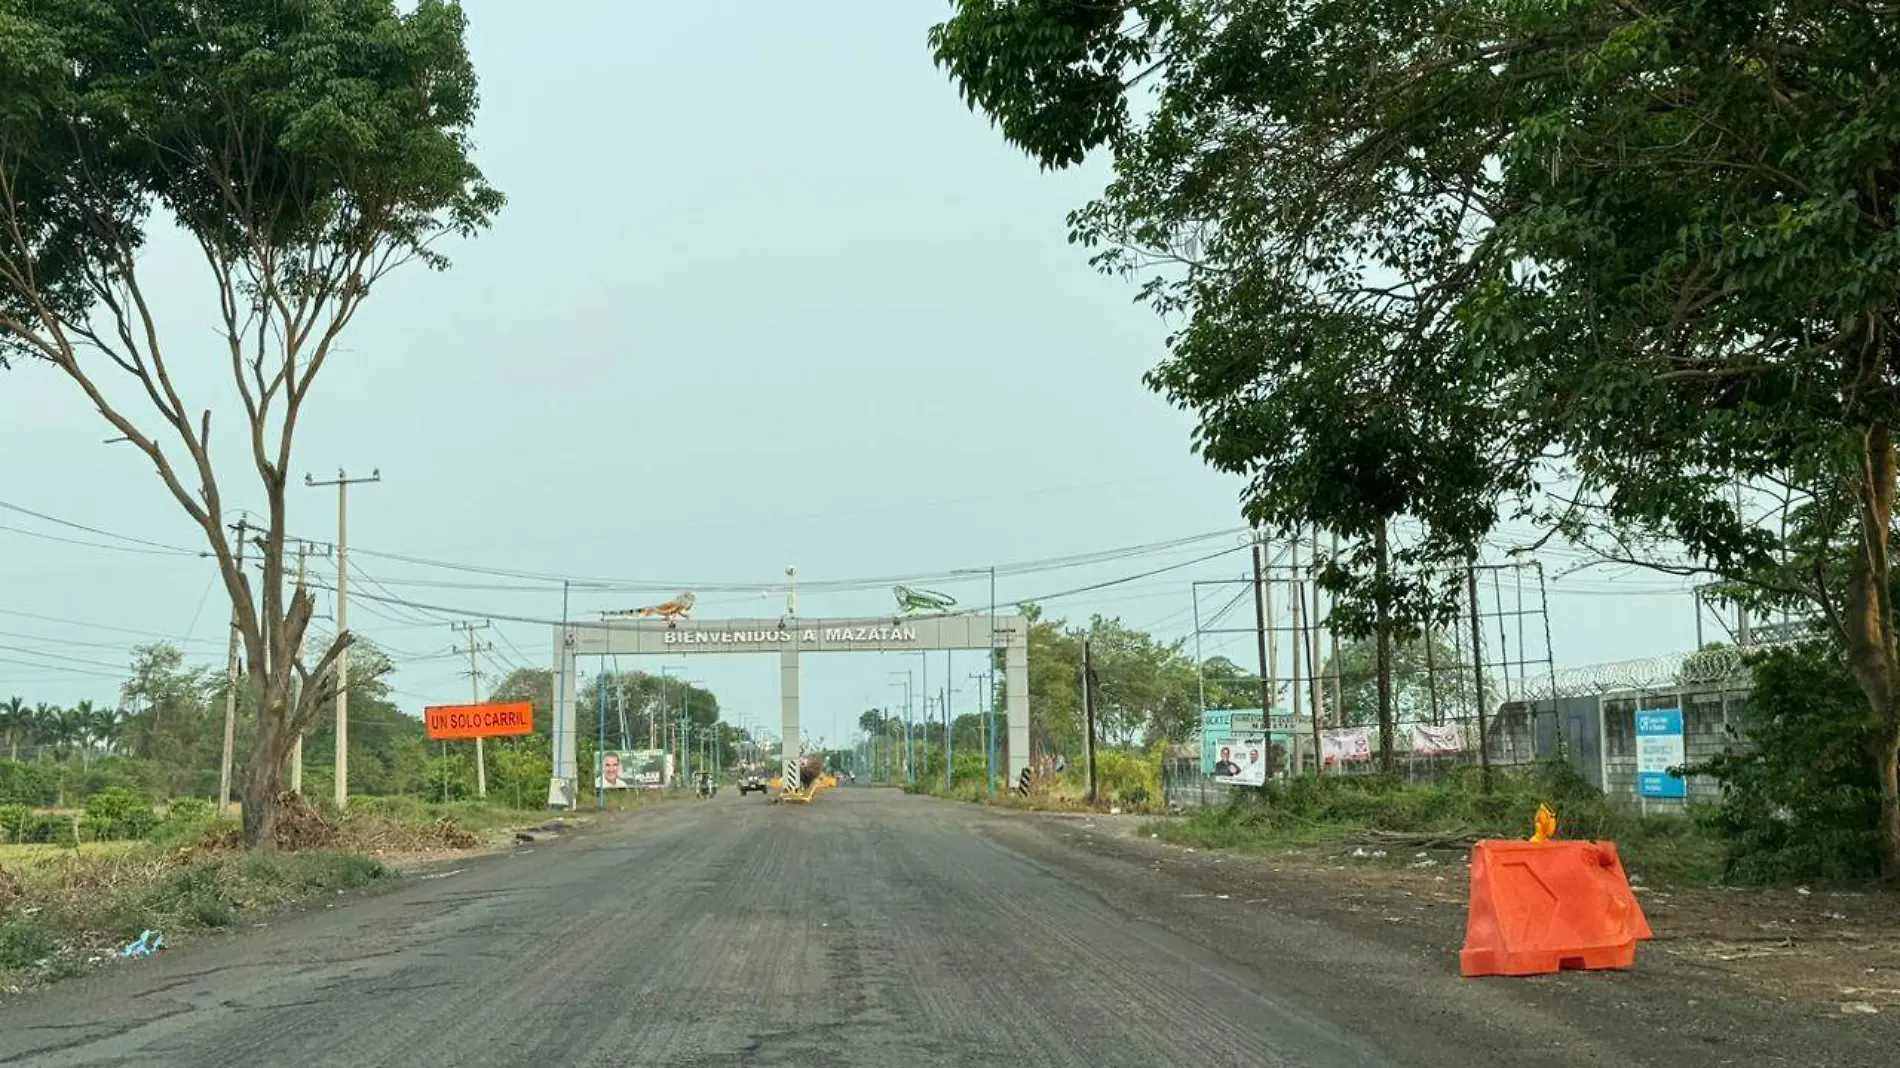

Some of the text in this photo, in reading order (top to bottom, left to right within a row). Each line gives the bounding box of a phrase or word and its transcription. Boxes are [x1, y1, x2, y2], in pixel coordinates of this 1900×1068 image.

[664, 630, 791, 643] BIENVENIDOS
[803, 629, 816, 641] A
[431, 711, 526, 729] UN SOLO CARRIL
